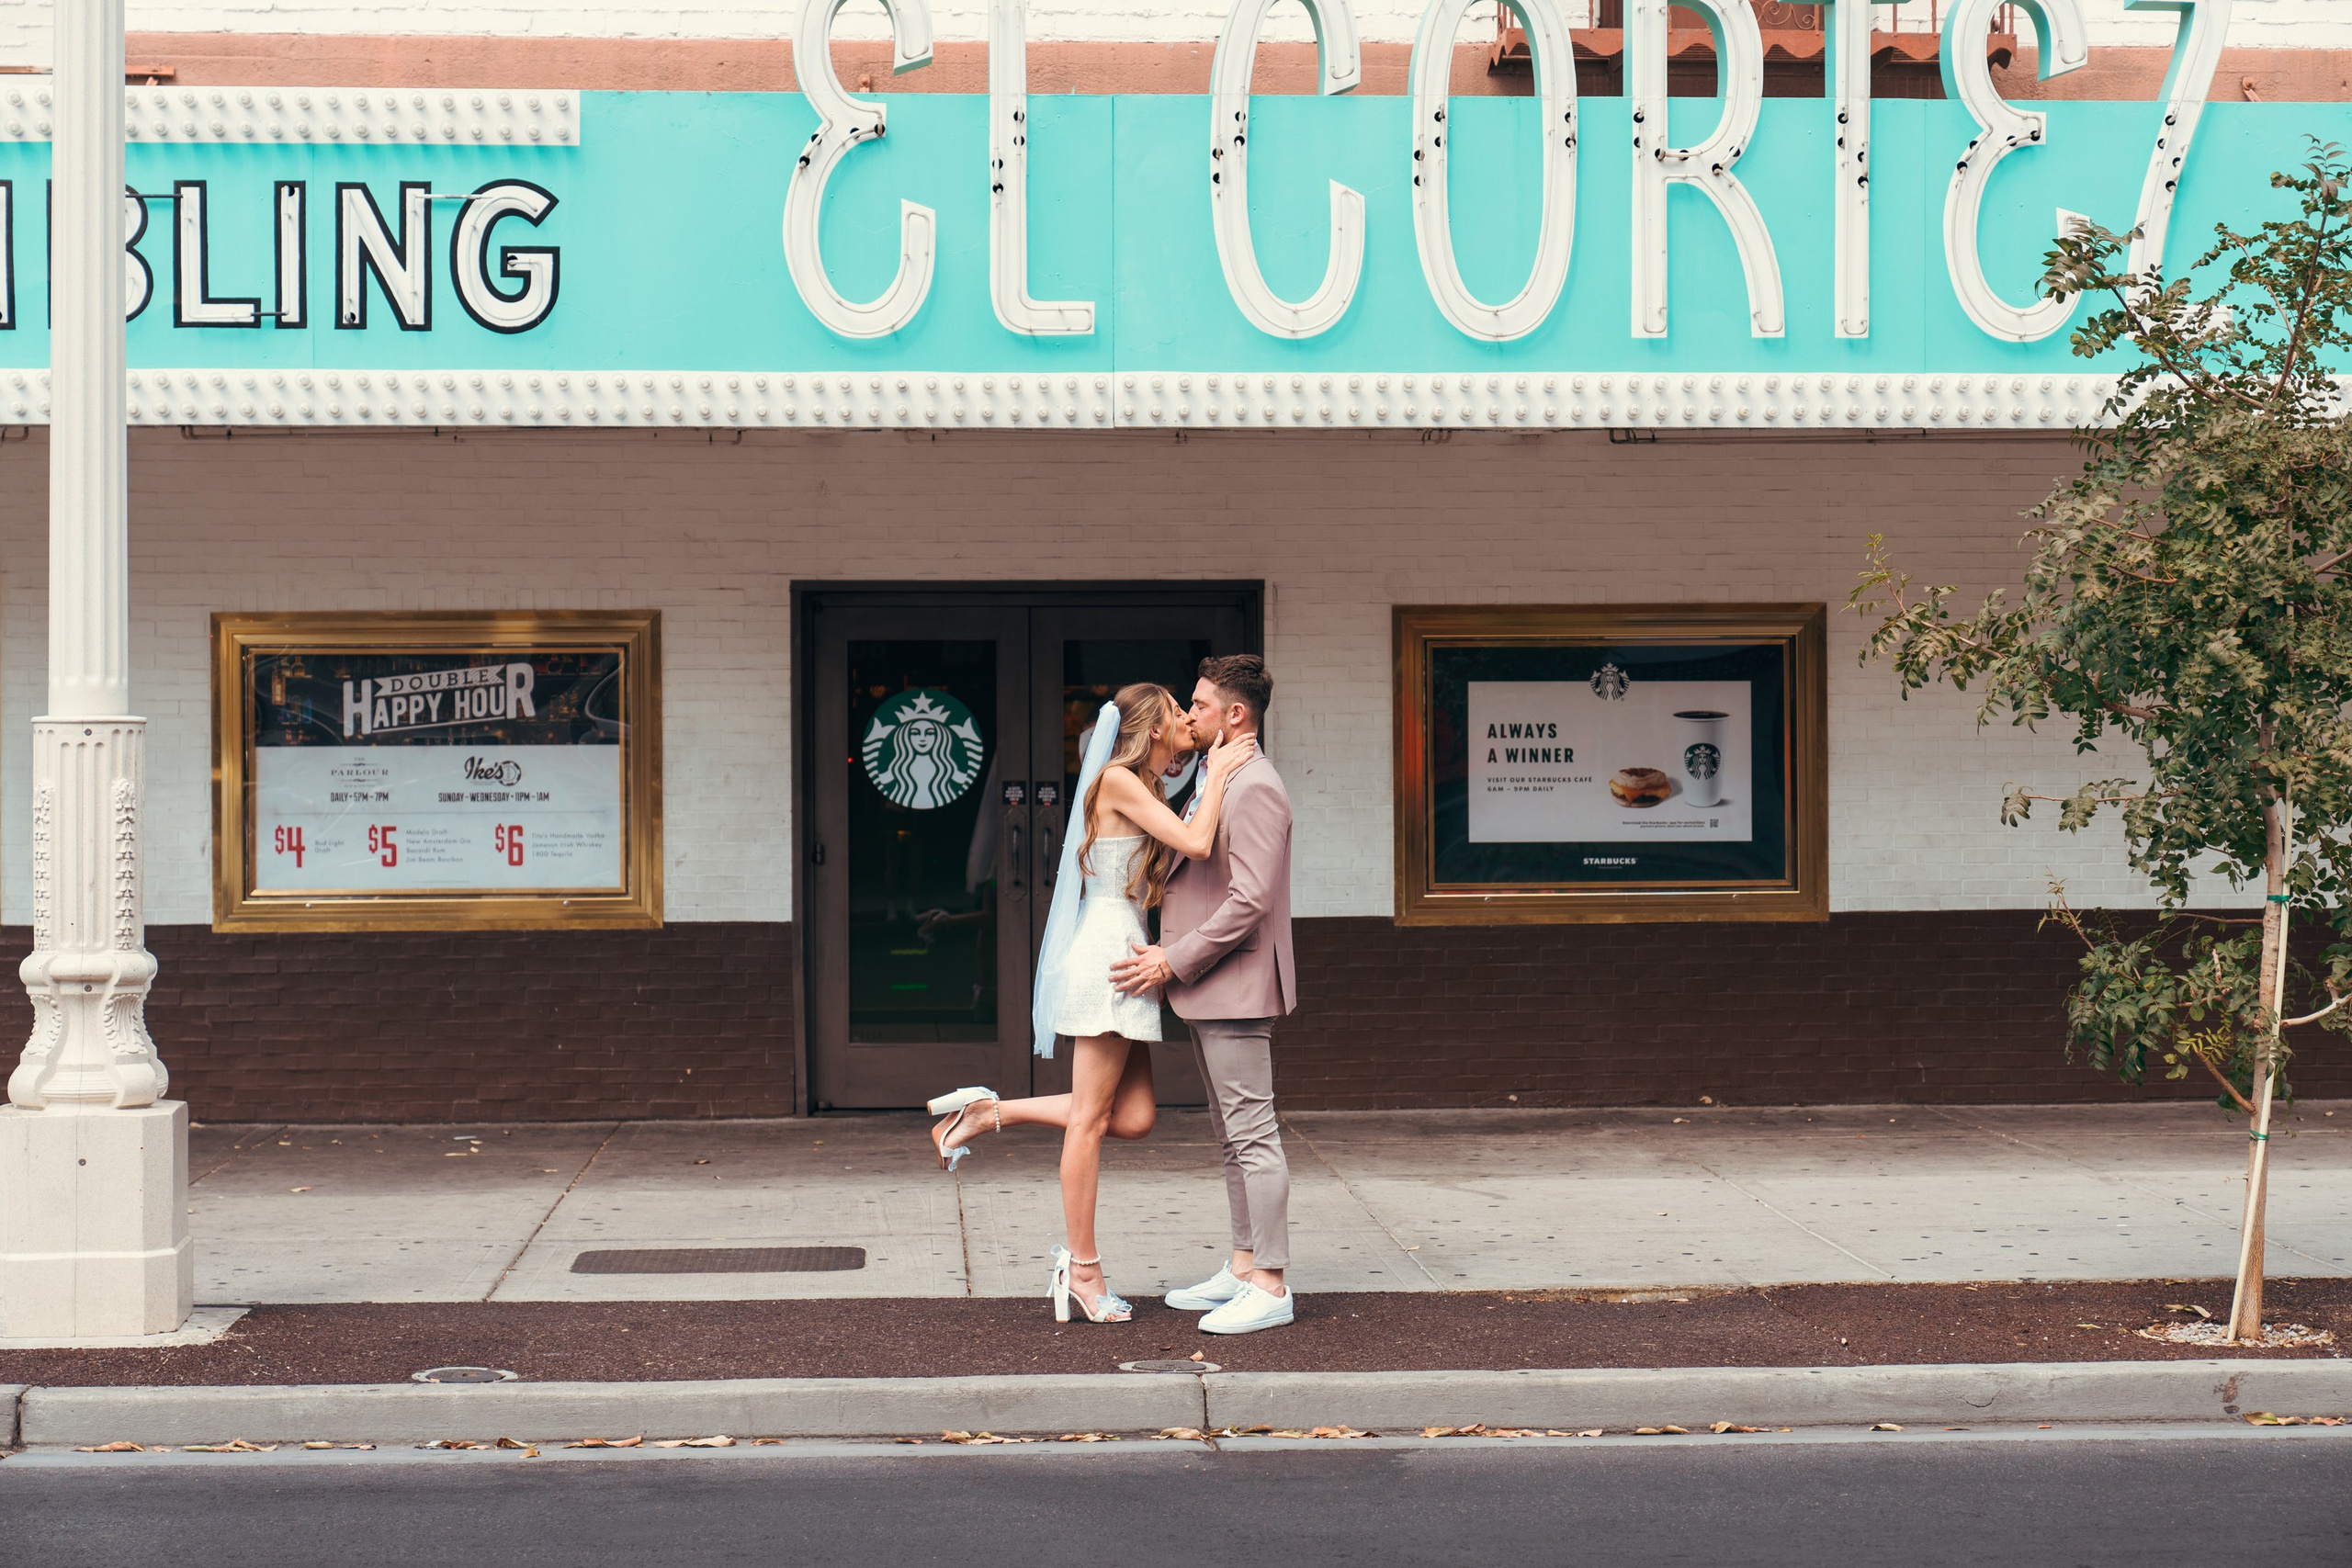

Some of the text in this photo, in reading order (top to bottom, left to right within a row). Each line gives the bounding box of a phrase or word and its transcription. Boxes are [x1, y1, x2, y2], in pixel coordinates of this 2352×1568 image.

[783, 0, 1096, 338] EL
[390, 669, 490, 693] DOUBLE
[343, 662, 537, 736] HAPPY HOUR
[1487, 723, 1557, 739] ALWAYS
[1487, 748, 1574, 763] A WINNER
[464, 756, 503, 780] Ike's
[331, 792, 348, 802] DAILY
[438, 792, 464, 803] SUNDAY
[469, 792, 510, 802] WEDNESDAY
[275, 825, 306, 868] $4
[368, 824, 397, 867] $5
[495, 823, 524, 866] $6
[1583, 857, 1637, 865] STARBUCKS
